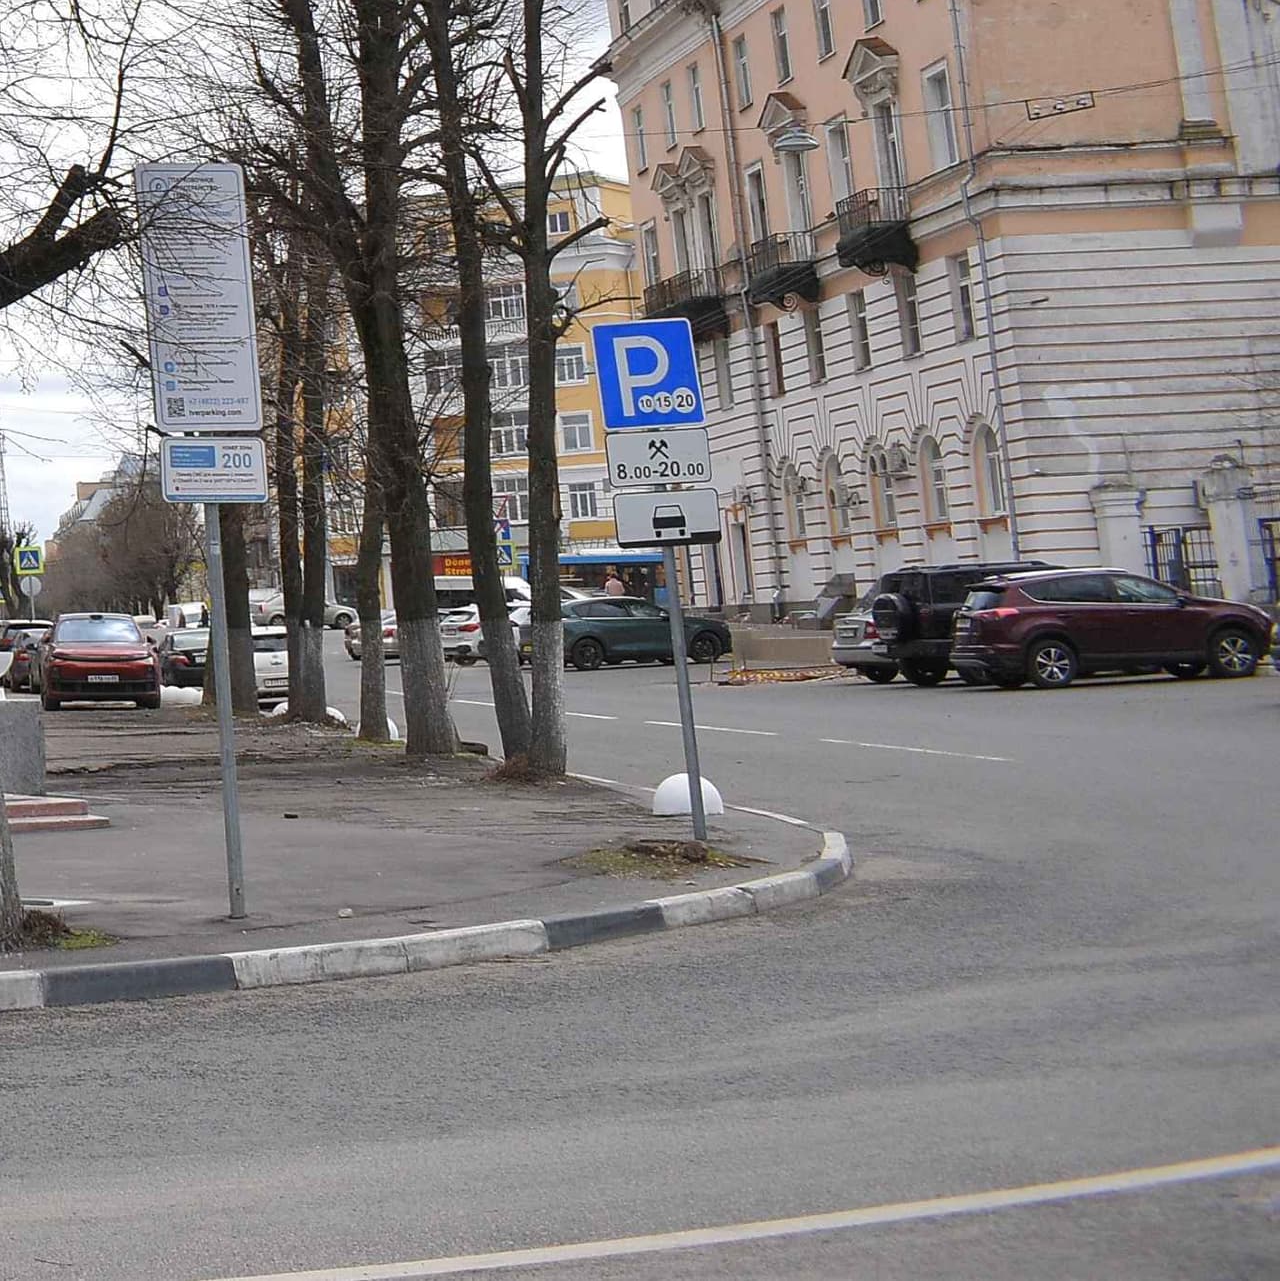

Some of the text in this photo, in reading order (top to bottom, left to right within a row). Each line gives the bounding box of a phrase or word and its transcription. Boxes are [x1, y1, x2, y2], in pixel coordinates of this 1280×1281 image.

[613, 336, 669, 417] P
[640, 394, 694, 408] 10 15 20
[222, 453, 252, 468] 200
[617, 461, 704, 479] 8.00-20.00
